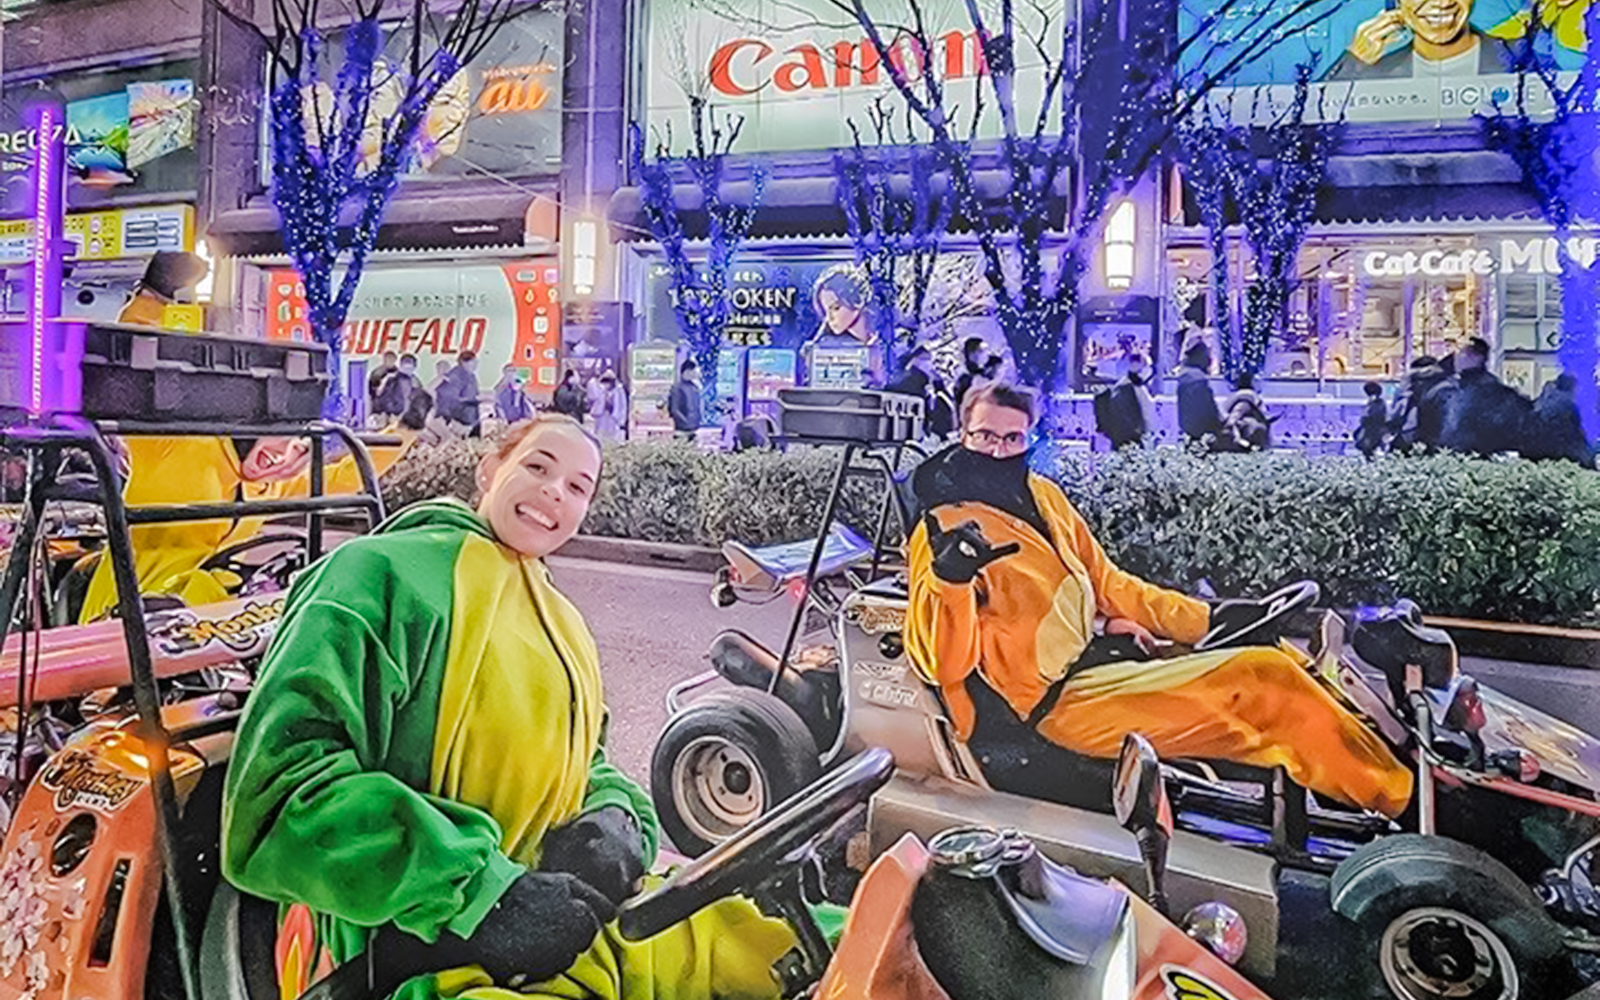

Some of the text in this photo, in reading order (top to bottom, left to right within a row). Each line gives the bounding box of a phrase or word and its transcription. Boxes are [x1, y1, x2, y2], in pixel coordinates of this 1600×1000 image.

[709, 29, 993, 96] Canon
[479, 80, 553, 114] au
[1442, 85, 1537, 106] BIGLOE
[1364, 251, 1418, 275] Cat
[1420, 249, 1493, 275] Café
